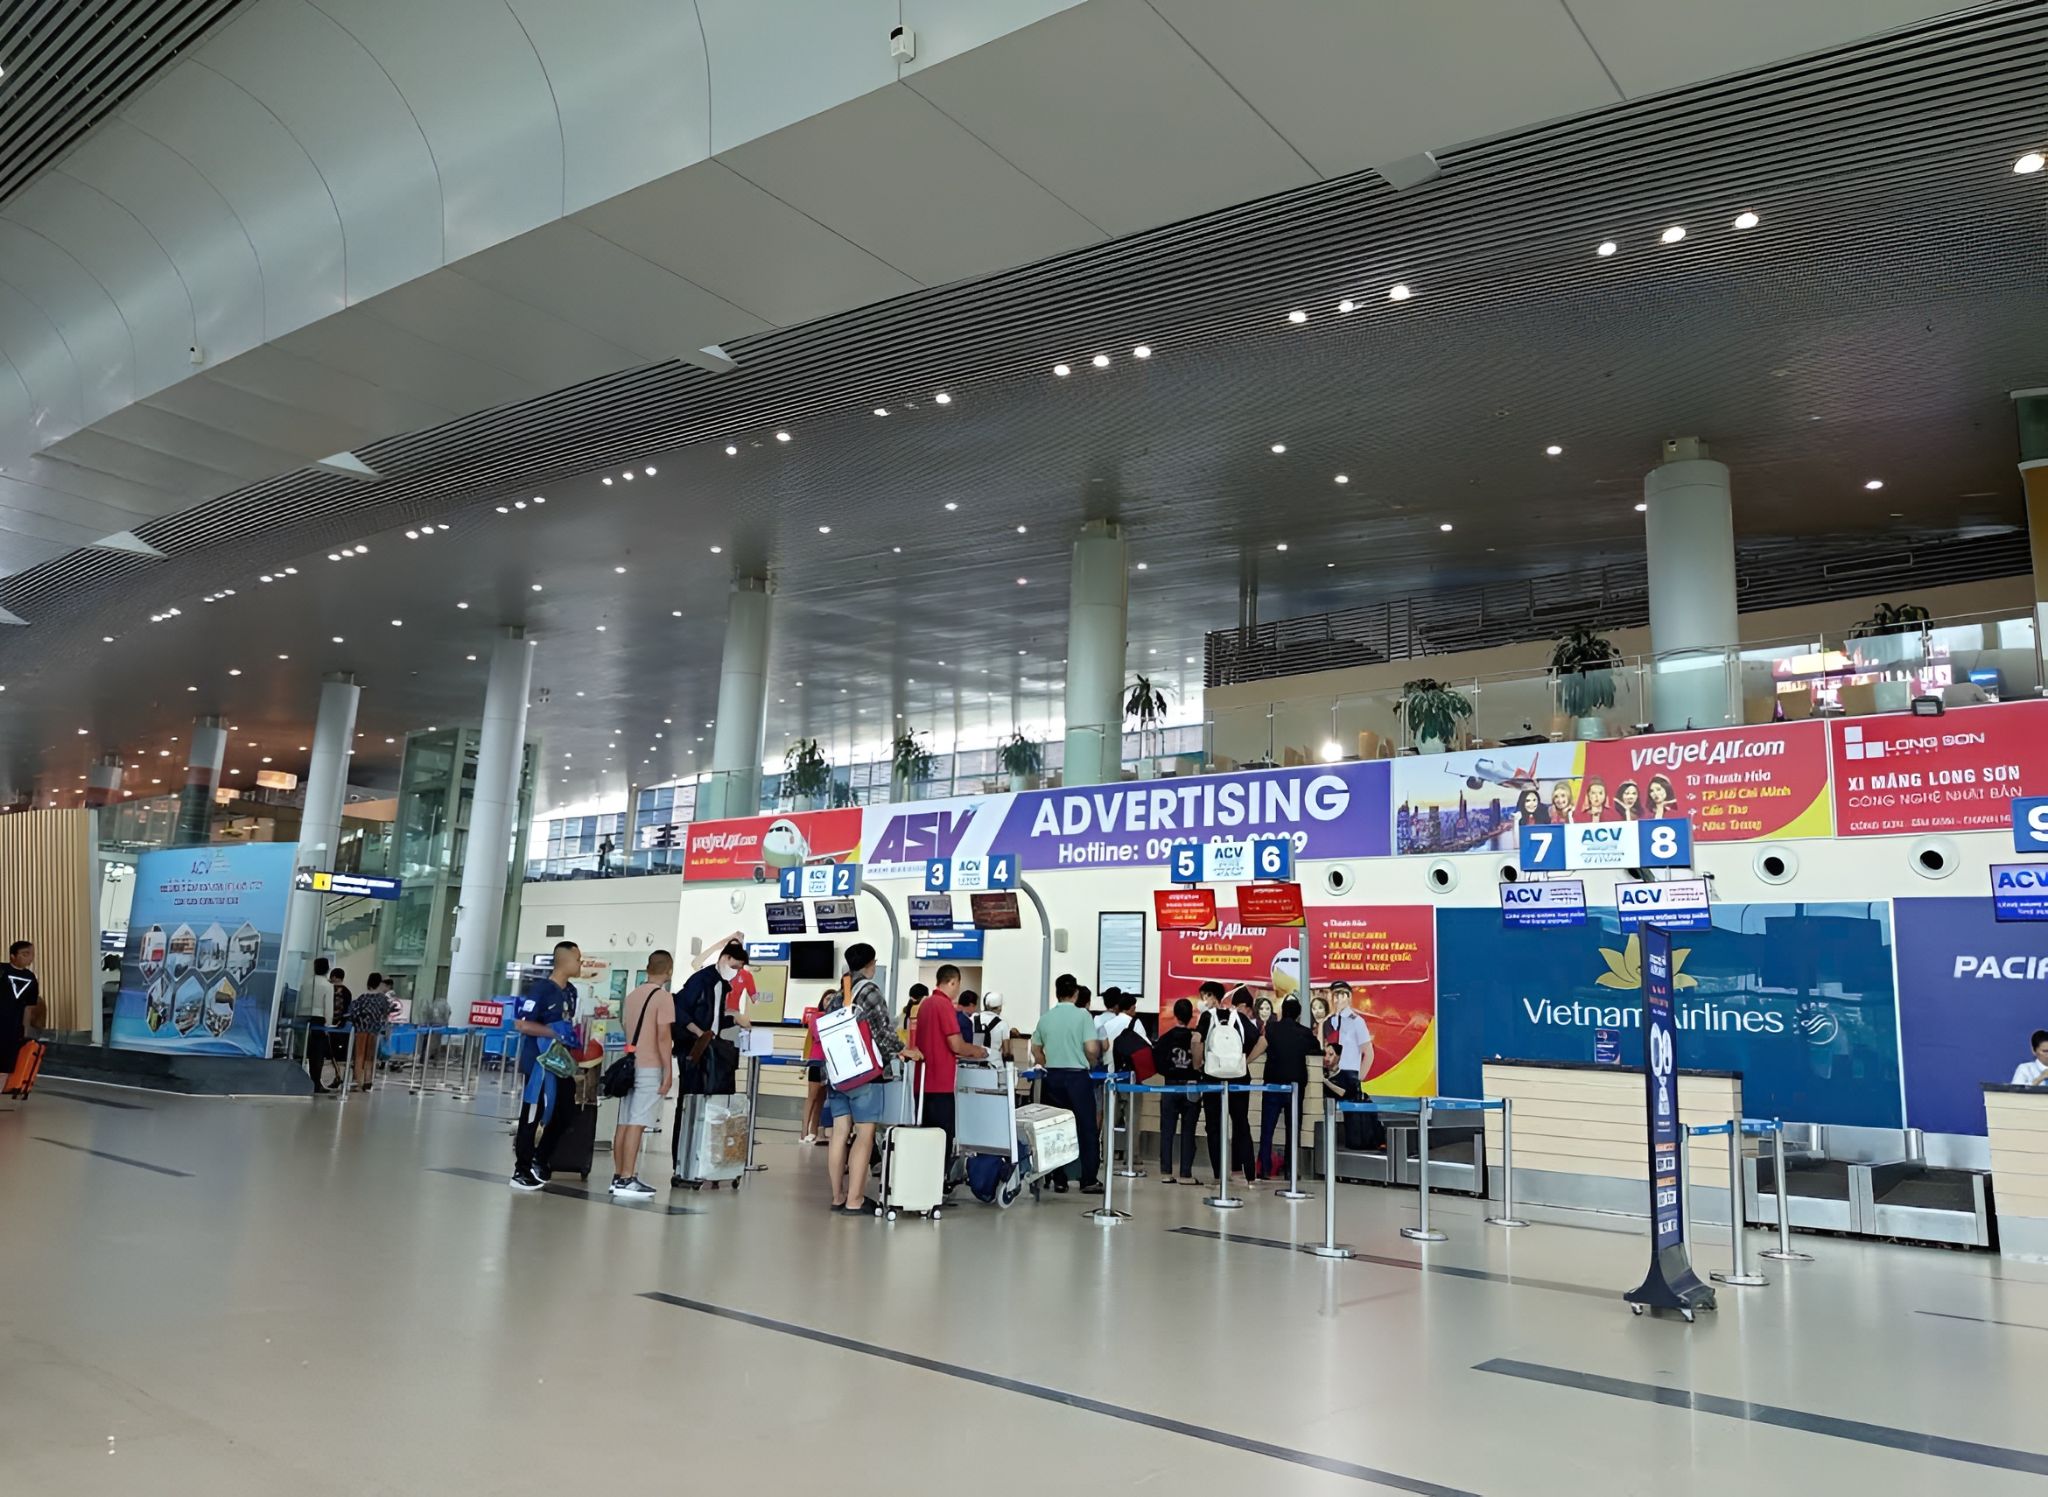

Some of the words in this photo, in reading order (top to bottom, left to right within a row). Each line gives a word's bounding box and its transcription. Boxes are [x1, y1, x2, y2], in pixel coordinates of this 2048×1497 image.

[1848, 776, 1864, 791] XI
[1928, 768, 1976, 786] LONG
[1030, 775, 1350, 838] ADVERTISING
[868, 809, 978, 865] ASV
[1530, 832, 1553, 863] 7
[1581, 828, 1622, 842] ACV
[1650, 826, 1678, 859] 8
[1058, 840, 1138, 864] Hotline:
[1178, 851, 1195, 876] 5
[1214, 846, 1243, 859] ACV
[1261, 846, 1281, 873] 6
[786, 871, 795, 894] 1
[837, 869, 849, 891] 2
[930, 863, 944, 886] 3
[993, 860, 1008, 882] 4
[1504, 888, 1543, 903] ACV
[1621, 888, 1662, 905] ACV
[1523, 997, 1643, 1028] Vietnam
[1673, 1002, 1784, 1033] irlines
